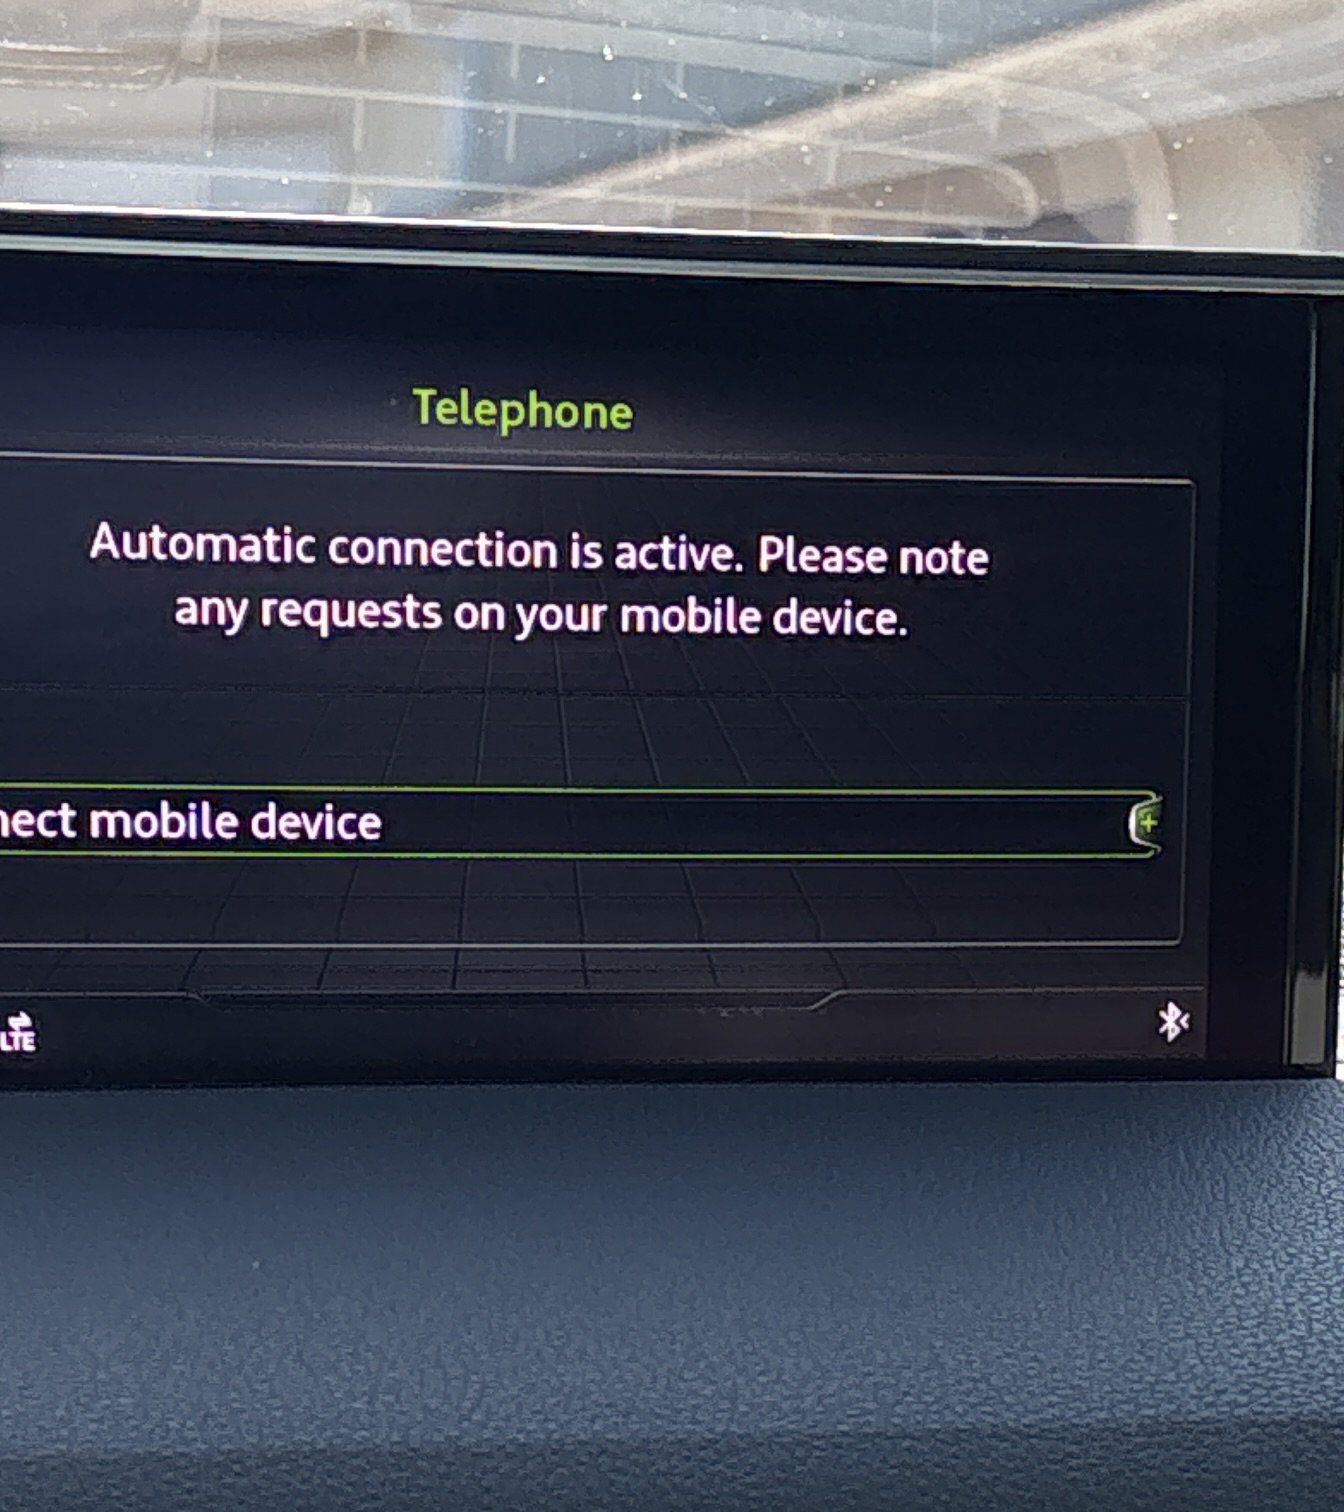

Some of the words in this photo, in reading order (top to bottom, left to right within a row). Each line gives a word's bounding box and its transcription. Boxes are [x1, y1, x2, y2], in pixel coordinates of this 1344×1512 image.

[412, 386, 634, 438] Telephone
[88, 520, 317, 565] Automatic
[328, 528, 559, 570] connection
[570, 530, 604, 570] is
[614, 532, 745, 573] active.
[758, 534, 890, 575] Please
[899, 540, 991, 577] note
[173, 595, 250, 638] any
[261, 593, 445, 640] requests
[453, 601, 507, 632] on
[514, 603, 610, 643] your
[620, 594, 764, 636] mobile
[772, 596, 909, 637] device.
[89, 798, 240, 841] mobile
[250, 800, 384, 842] device
